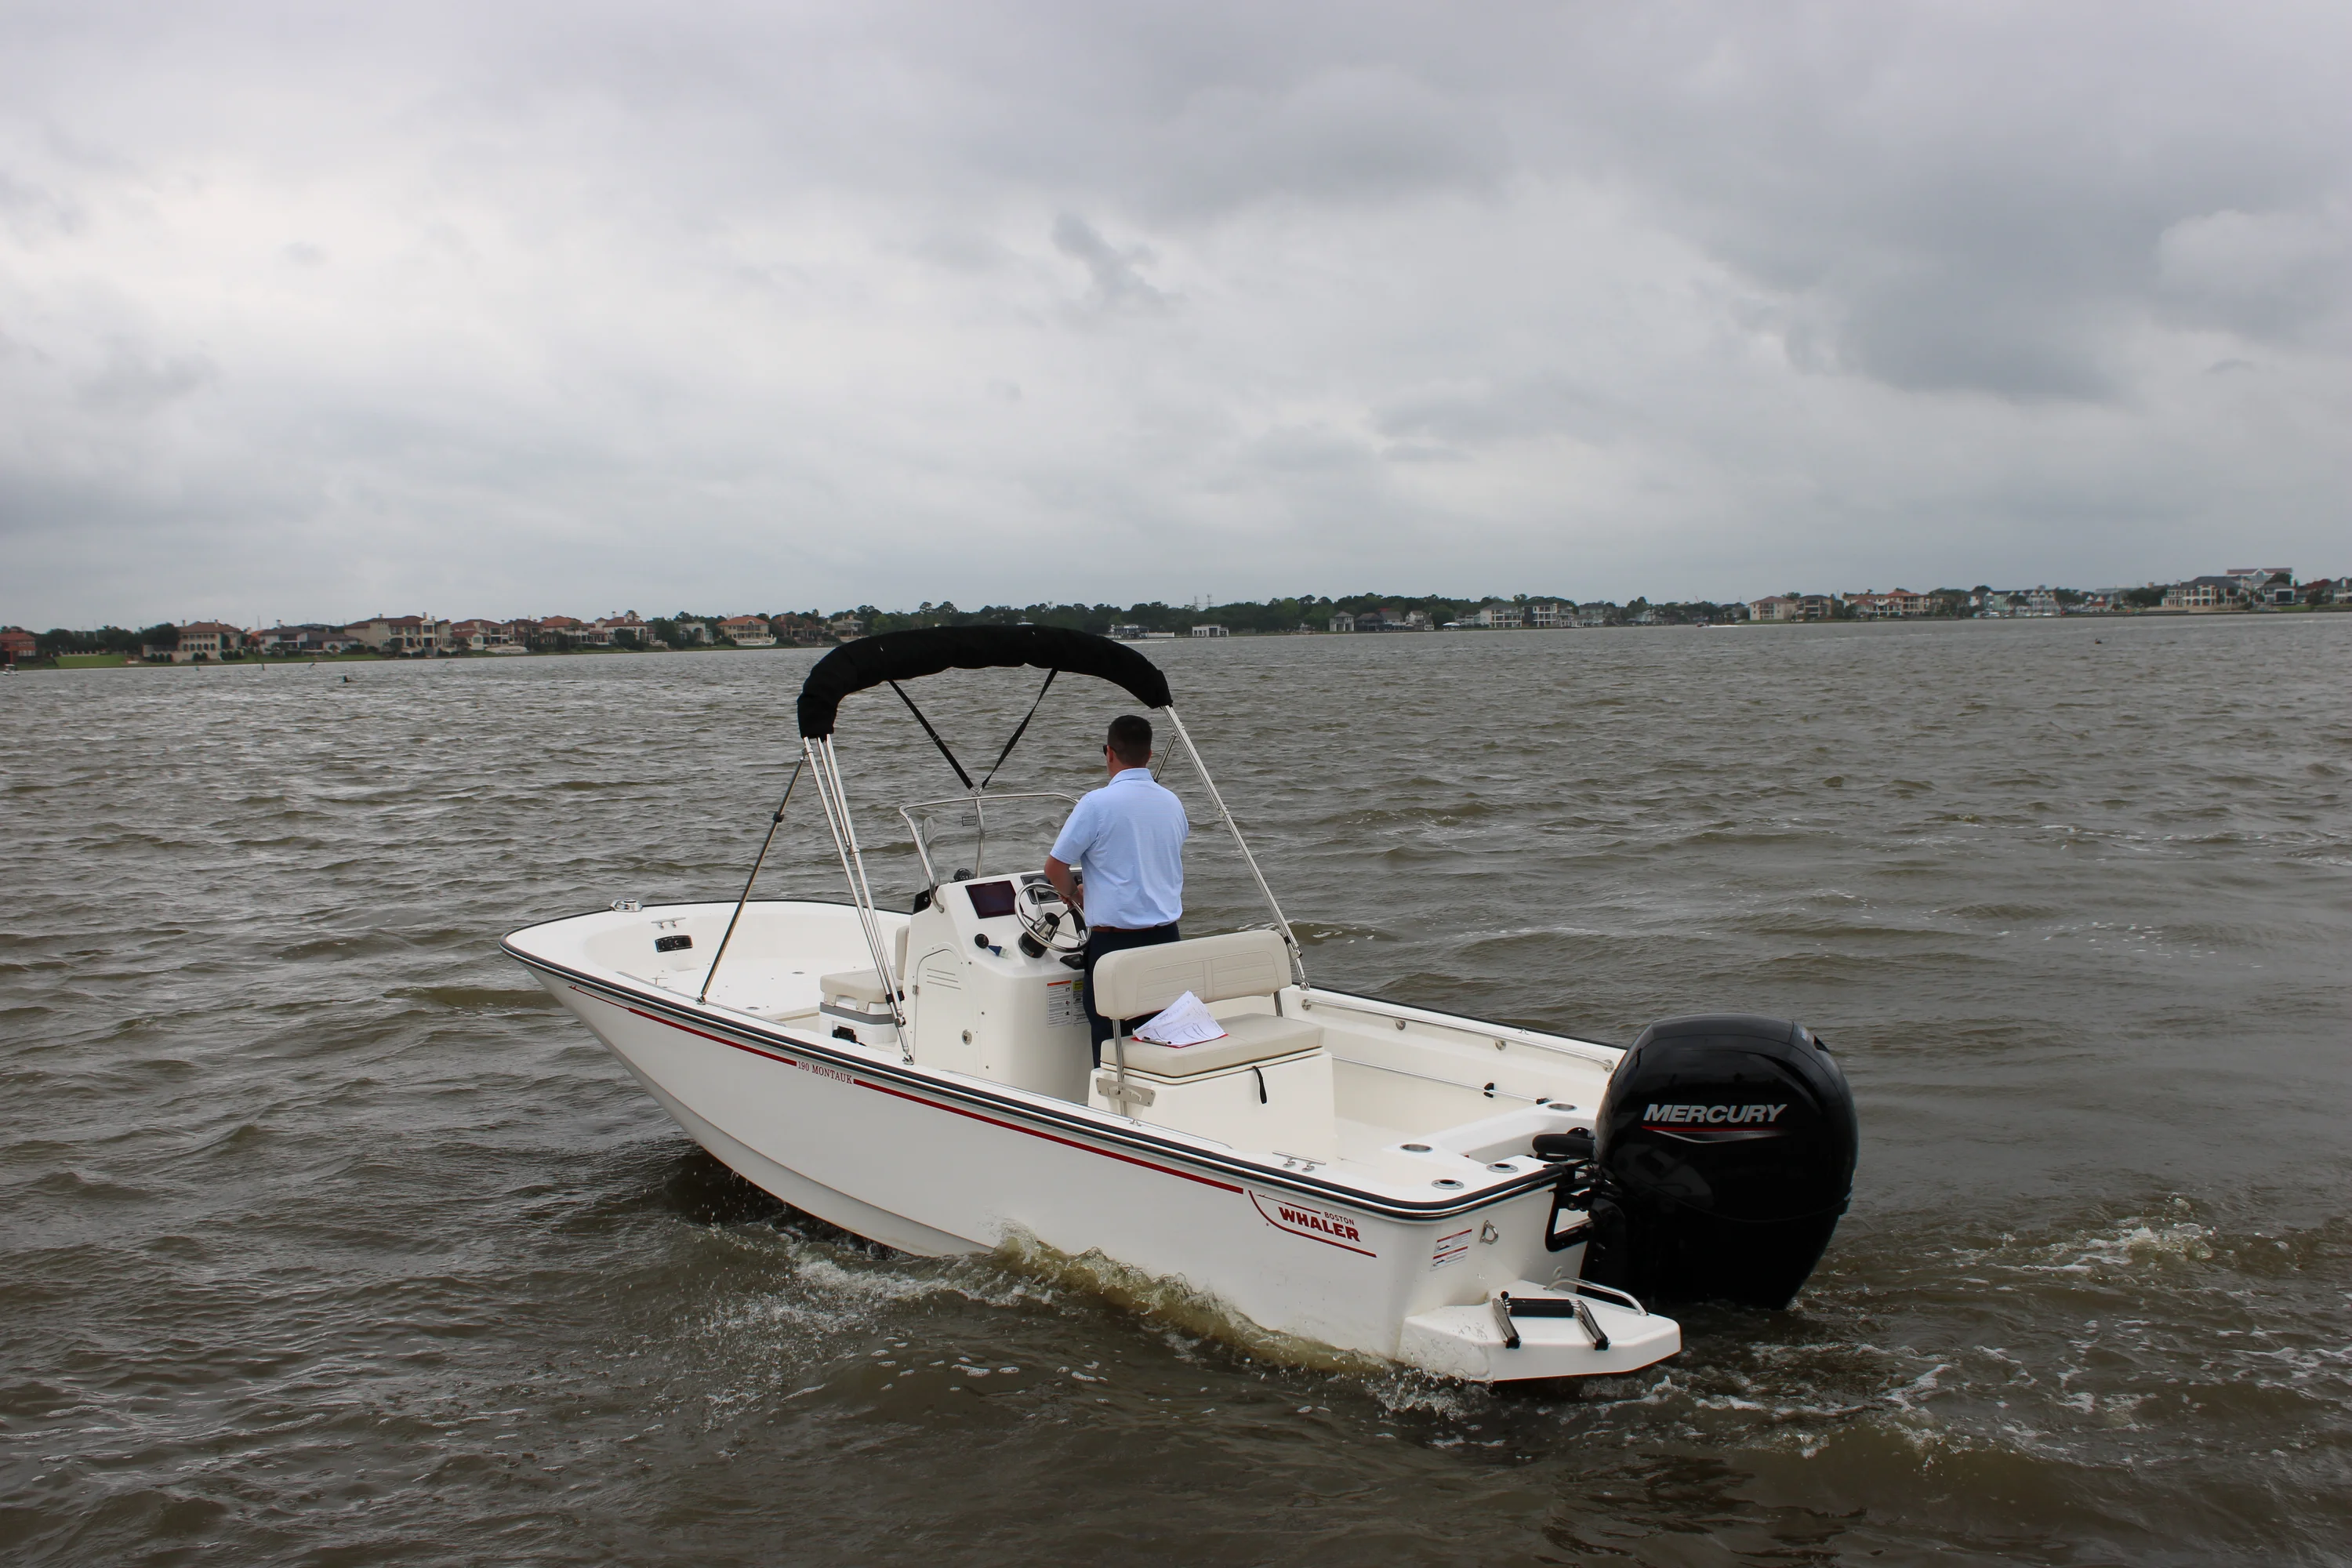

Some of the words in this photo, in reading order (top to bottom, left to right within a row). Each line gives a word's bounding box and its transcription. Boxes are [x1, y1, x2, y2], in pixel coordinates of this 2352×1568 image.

[798, 1061, 810, 1071] 190
[811, 1064, 852, 1084] MONTAUK
[1643, 1104, 1788, 1123] MERCURY
[1278, 1206, 1361, 1242] WHALER
[1324, 1211, 1355, 1225] BOSTON
